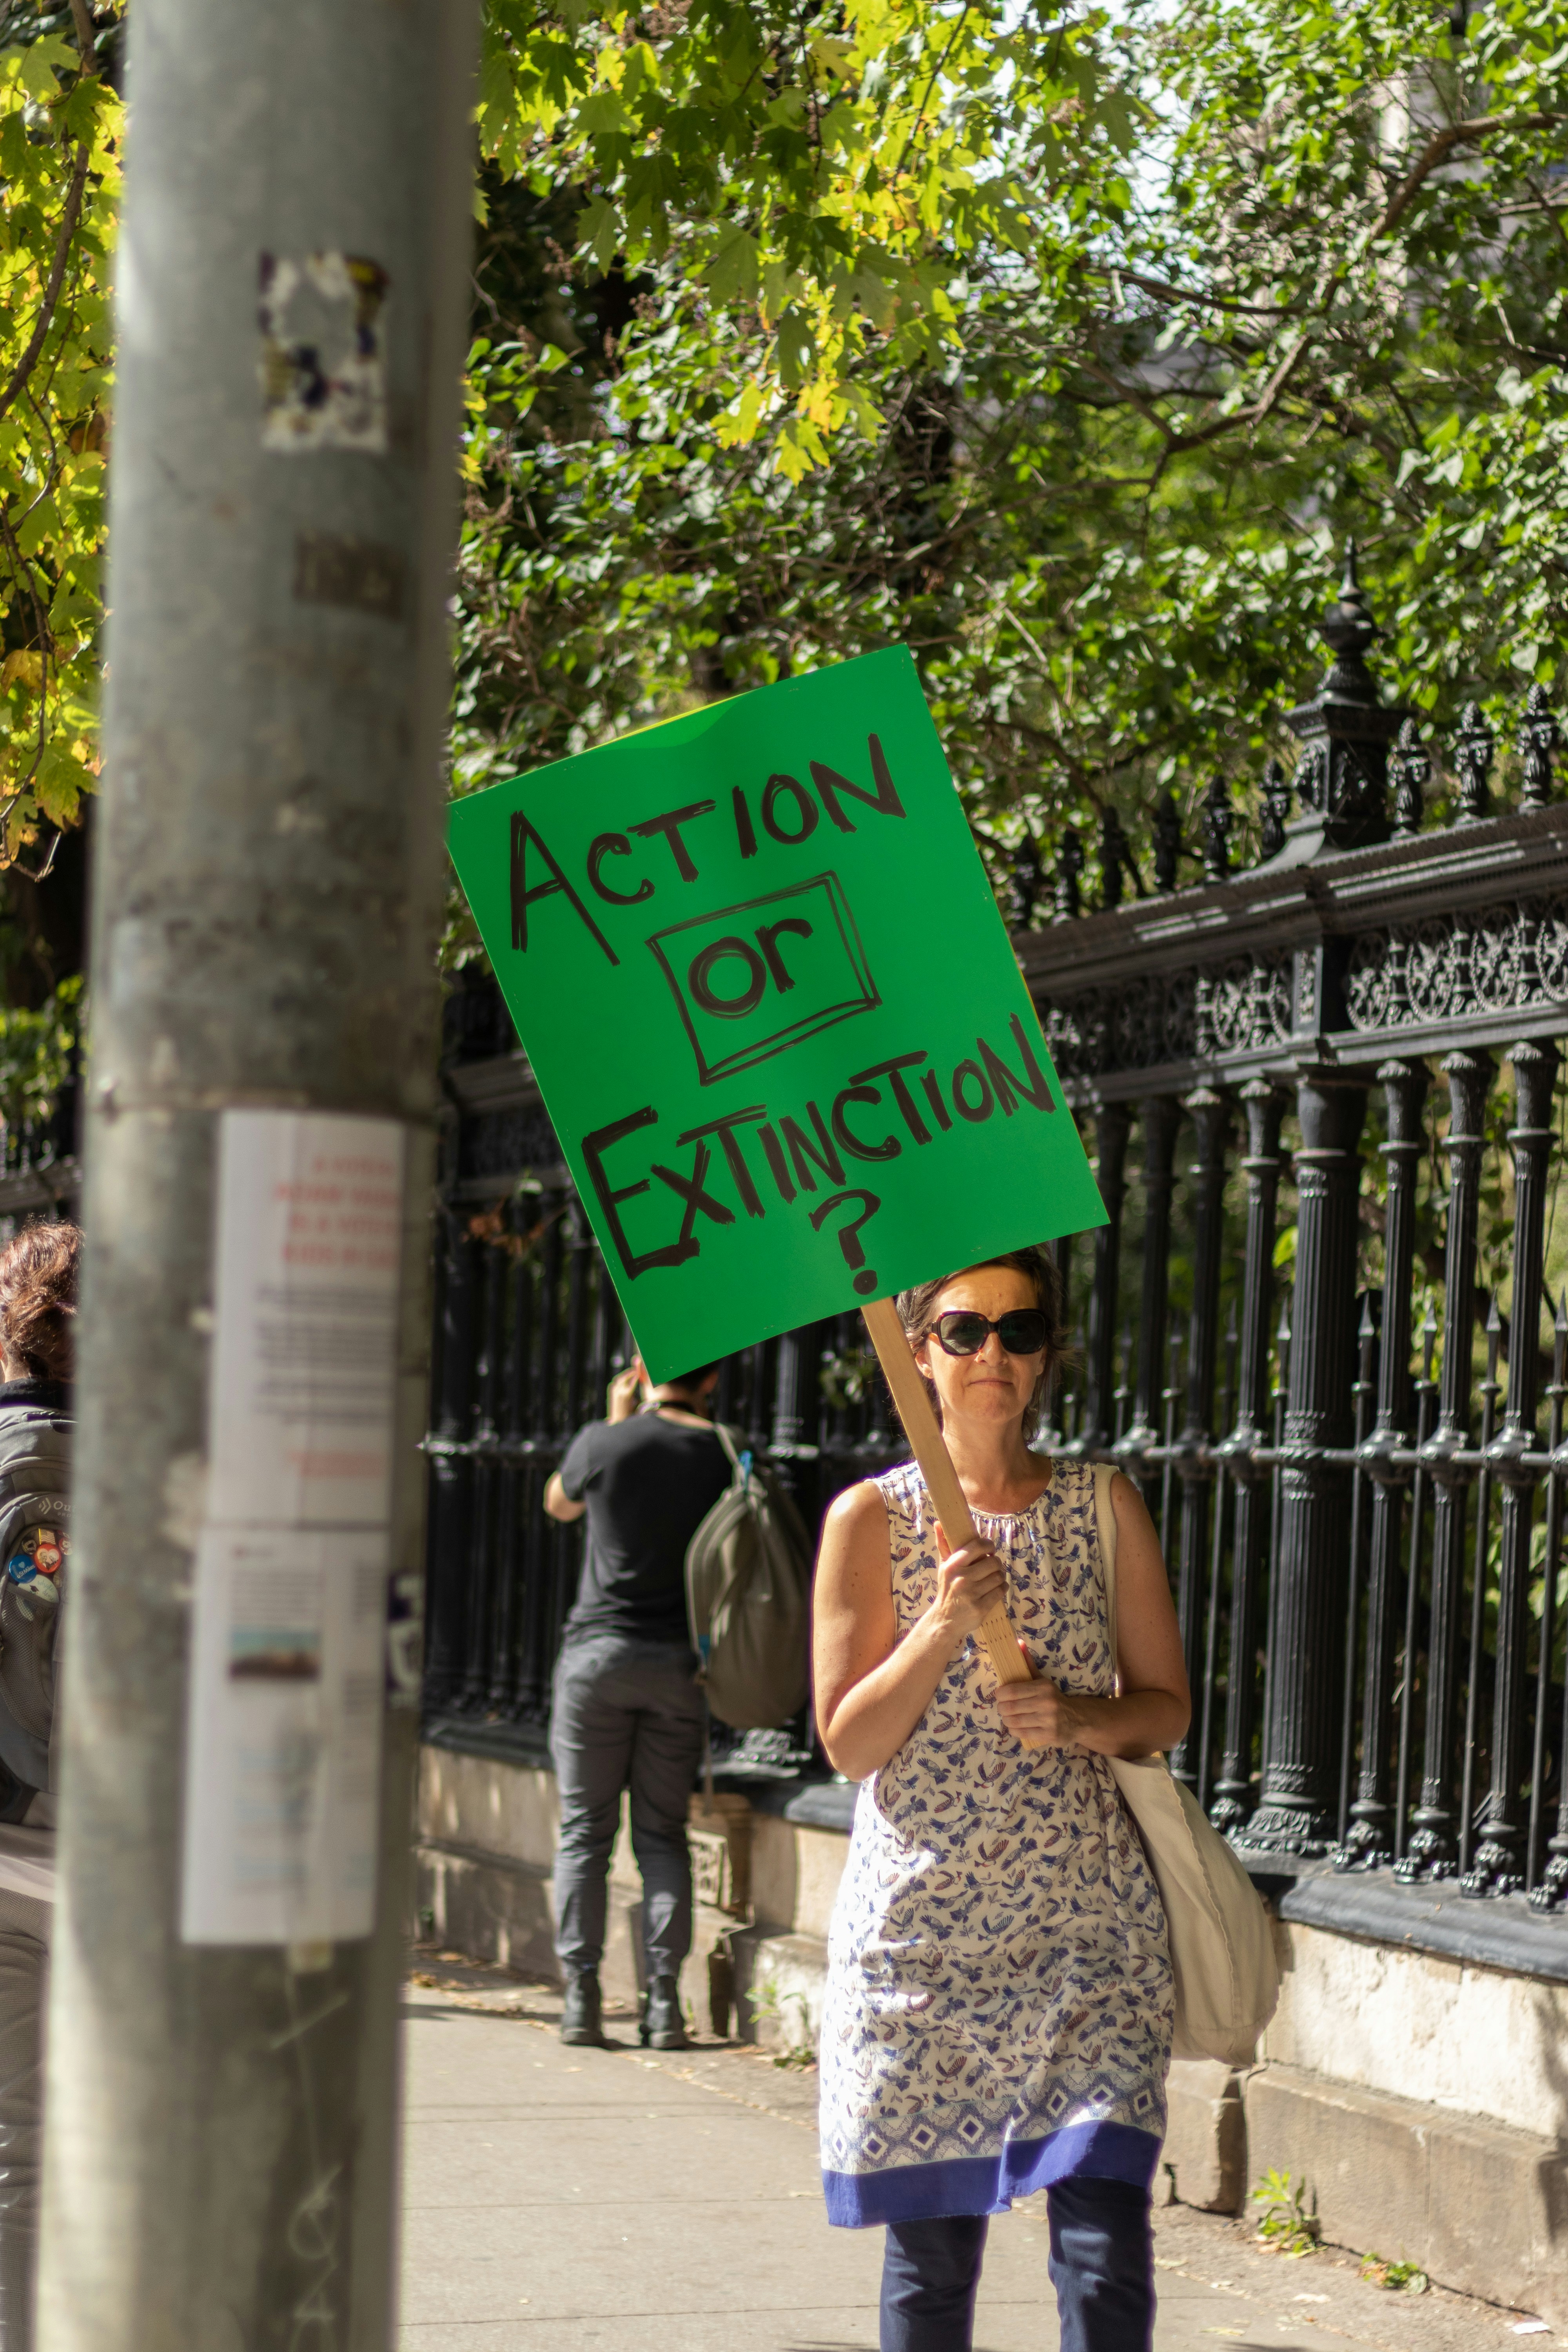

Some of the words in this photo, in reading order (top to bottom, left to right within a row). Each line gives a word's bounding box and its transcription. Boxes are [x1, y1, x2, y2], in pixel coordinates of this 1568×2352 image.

[510, 733, 906, 966] ACTION
[688, 918, 813, 1019] or
[582, 1013, 1056, 1280] EXTINCTION
[808, 1188, 881, 1295] ?
